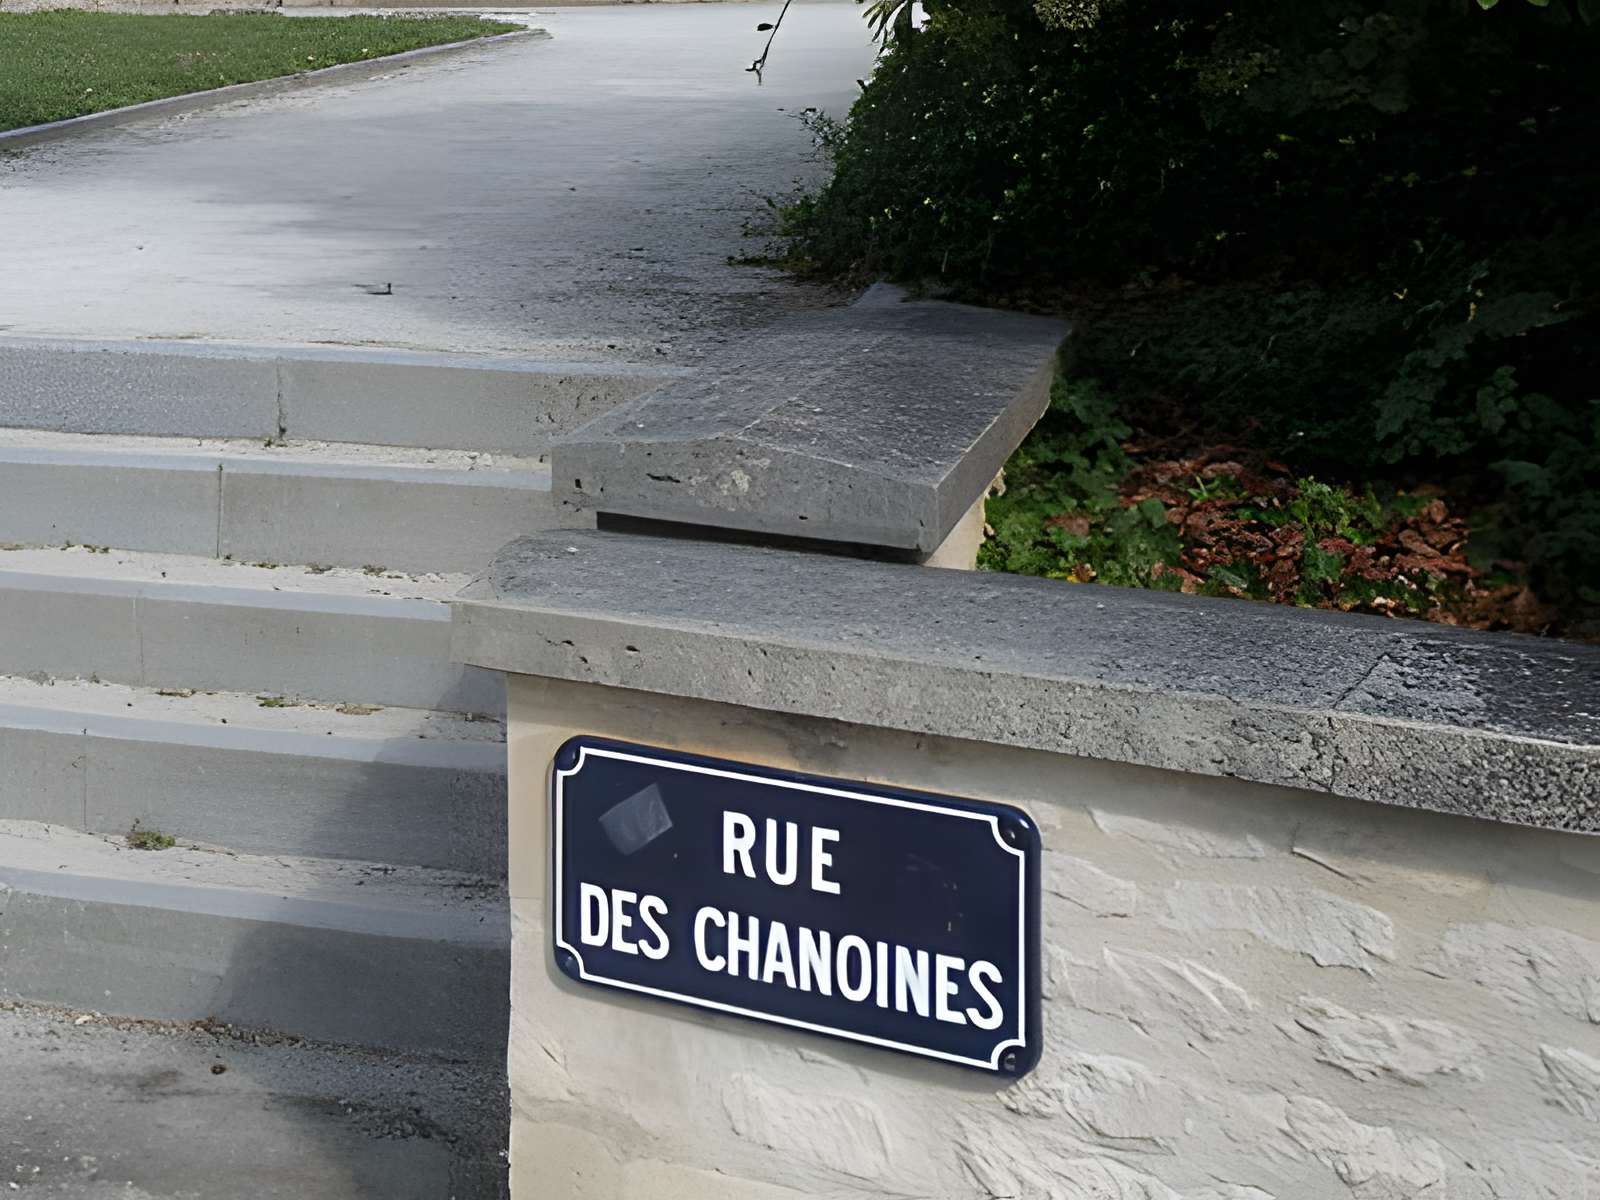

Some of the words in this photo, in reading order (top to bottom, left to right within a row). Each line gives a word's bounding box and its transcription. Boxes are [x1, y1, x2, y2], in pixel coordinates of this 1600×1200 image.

[722, 810, 841, 895] RUE
[579, 881, 670, 960] DES
[693, 905, 1004, 1031] CHANOINES
